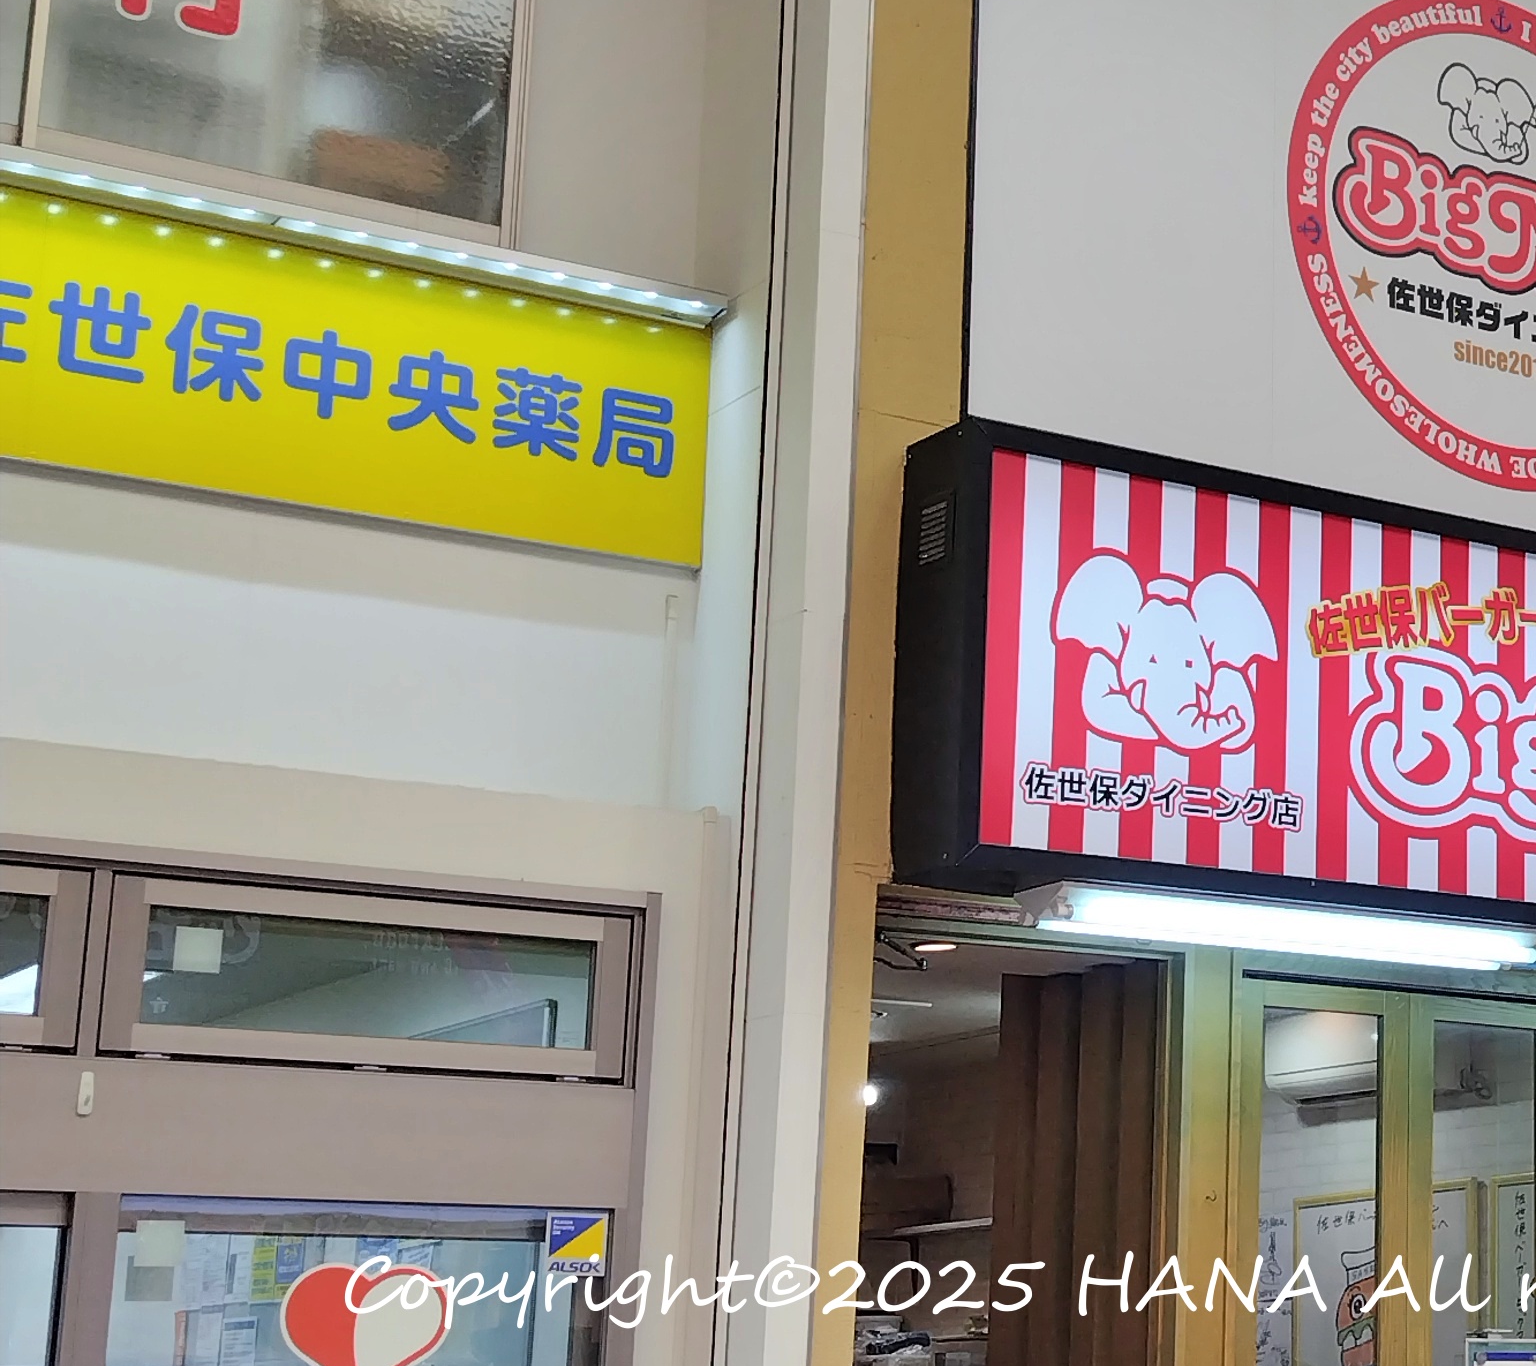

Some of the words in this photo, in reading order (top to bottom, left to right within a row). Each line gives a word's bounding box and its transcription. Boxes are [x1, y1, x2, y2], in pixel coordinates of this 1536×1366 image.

[1371, 2, 1483, 43] beautiful
[1520, 19, 1532, 41] I
[1335, 38, 1374, 82] city
[1311, 93, 1341, 128] the
[1298, 149, 1326, 208] keep
[1307, 252, 1503, 478] WHOLESOMENESS
[1023, 764, 1302, 831] 佐世保ダイニング店
[547, 1261, 600, 1273] ALSOK
